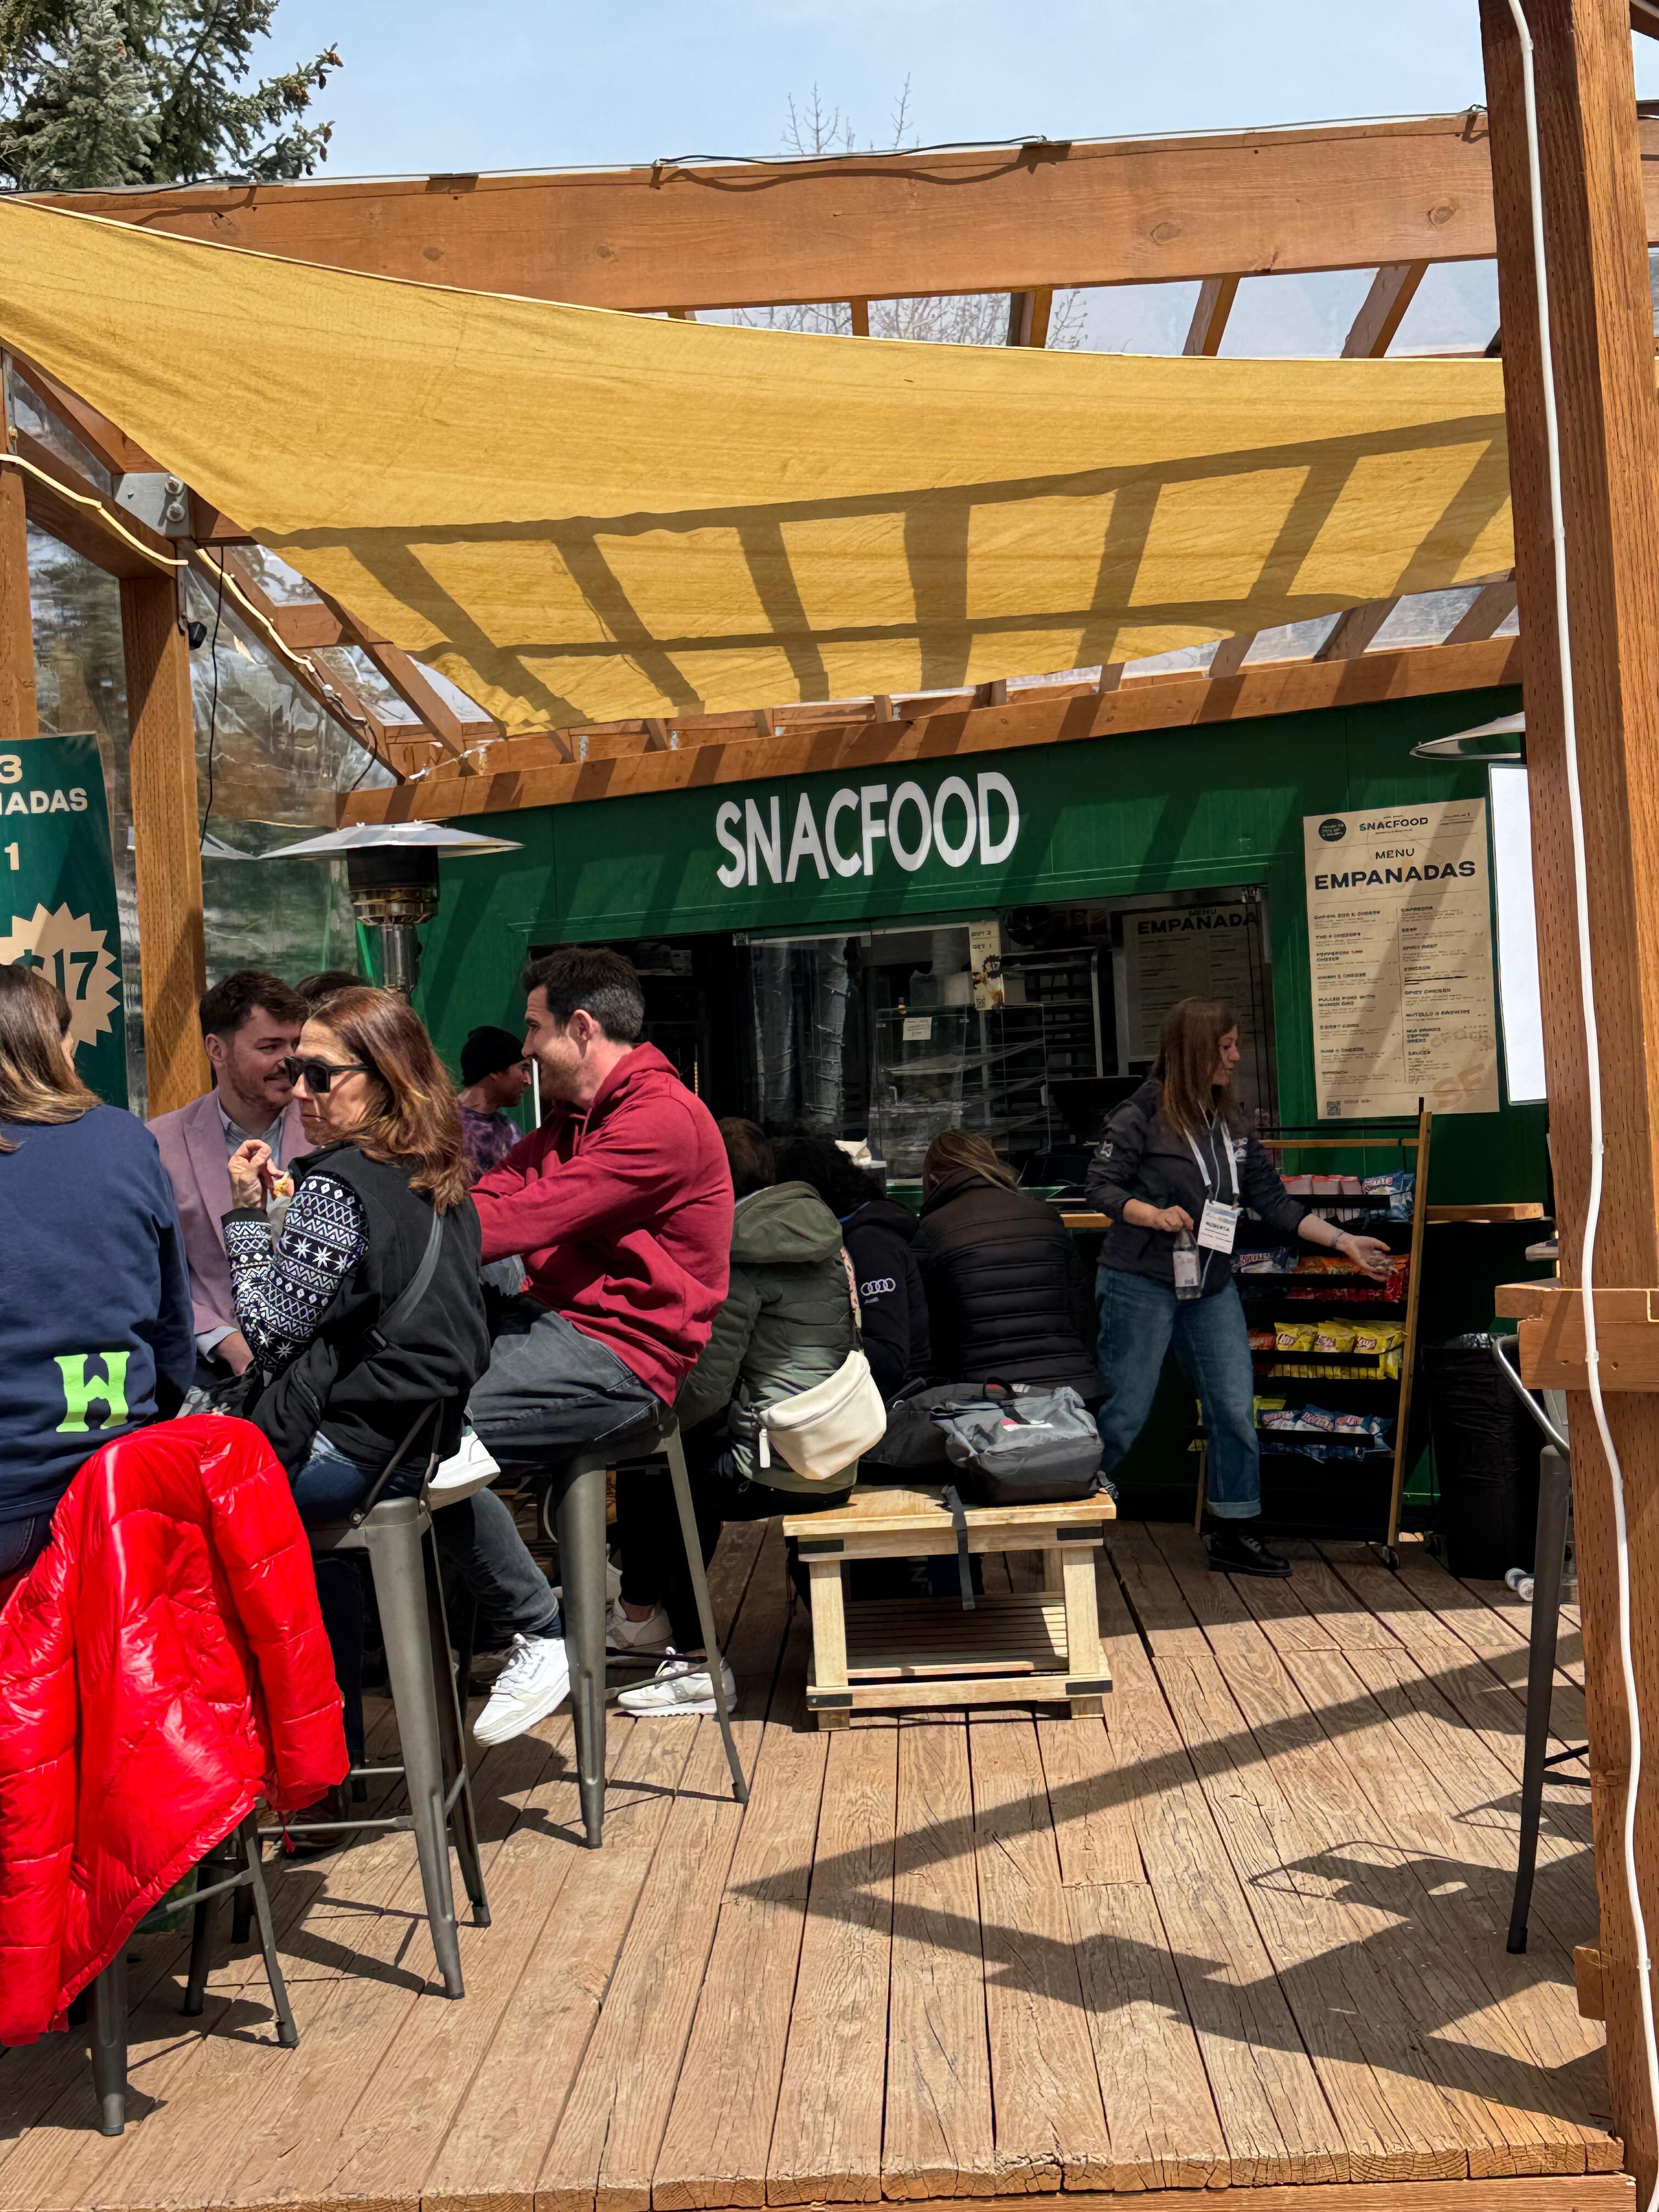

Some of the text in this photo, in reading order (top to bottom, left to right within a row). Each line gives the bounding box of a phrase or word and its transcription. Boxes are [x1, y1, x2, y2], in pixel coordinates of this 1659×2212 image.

[0, 754, 22, 784] 3
[0, 787, 88, 816] ADAS
[715, 771, 1019, 888] SNACFOOD
[1359, 817, 1429, 831] SNACFOOD
[4, 842, 20, 871] 1
[1375, 848, 1415, 860] MENU
[1314, 860, 1476, 890] EMPANADAS
